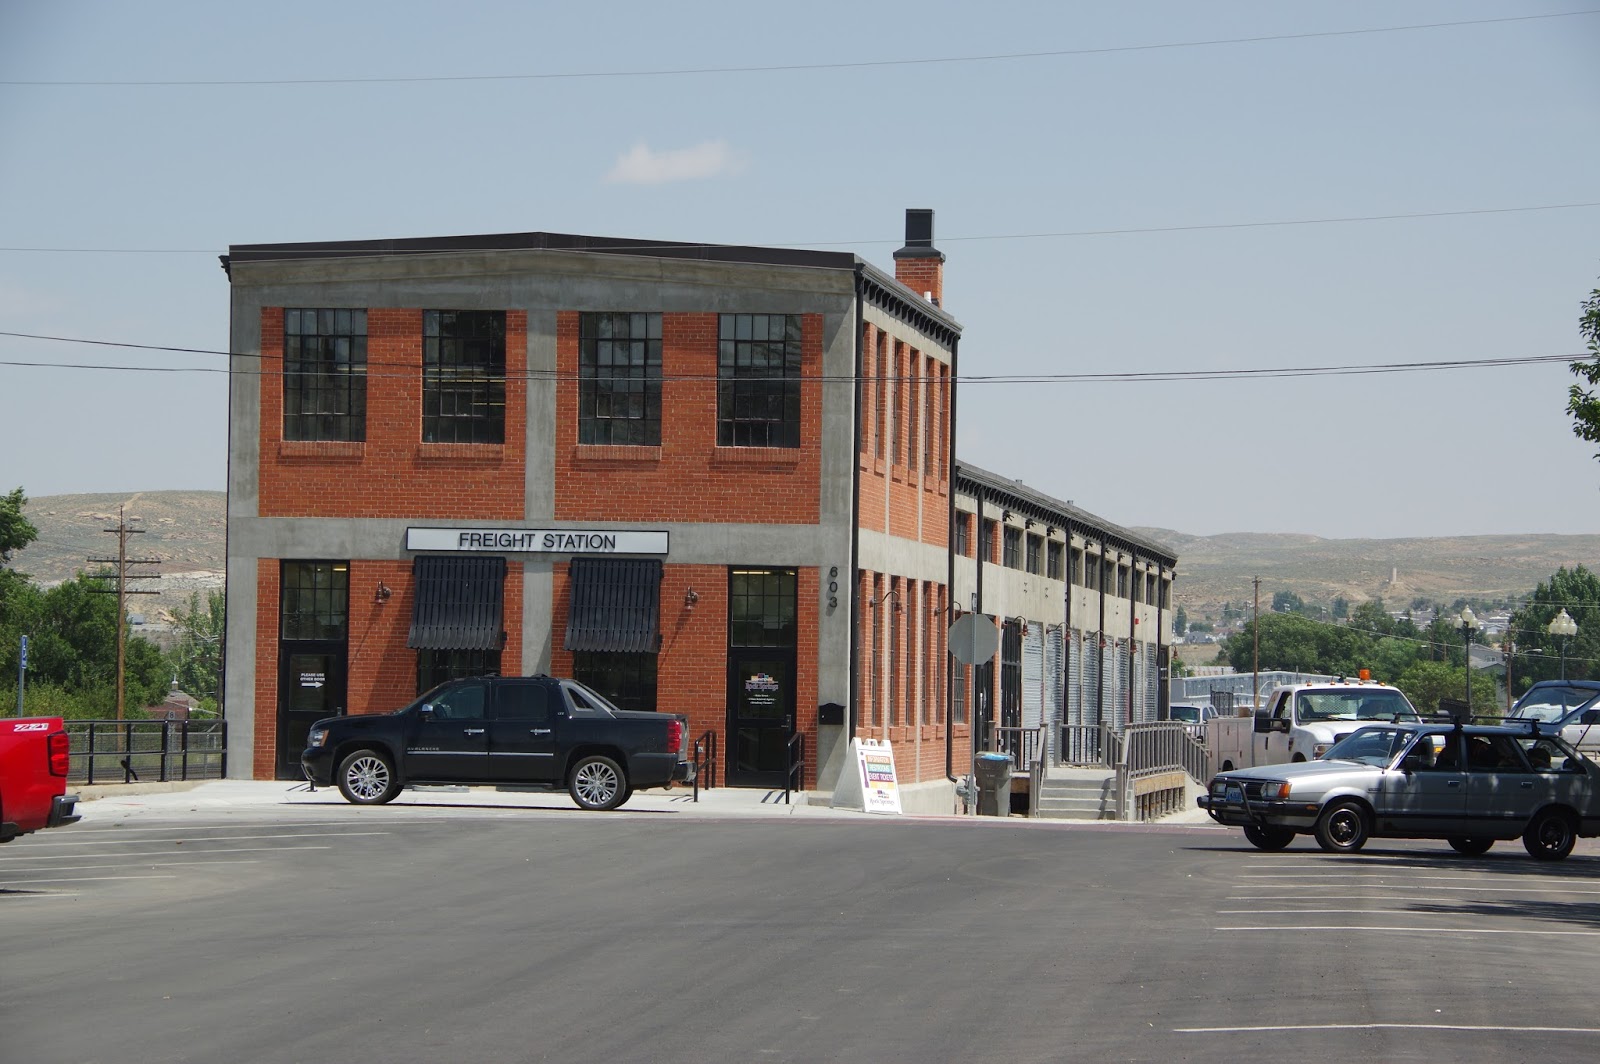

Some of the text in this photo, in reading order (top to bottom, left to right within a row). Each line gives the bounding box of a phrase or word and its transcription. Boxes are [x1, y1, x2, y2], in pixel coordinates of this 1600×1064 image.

[459, 532, 616, 549] FREIGHT STATION
[830, 566, 838, 608] 603
